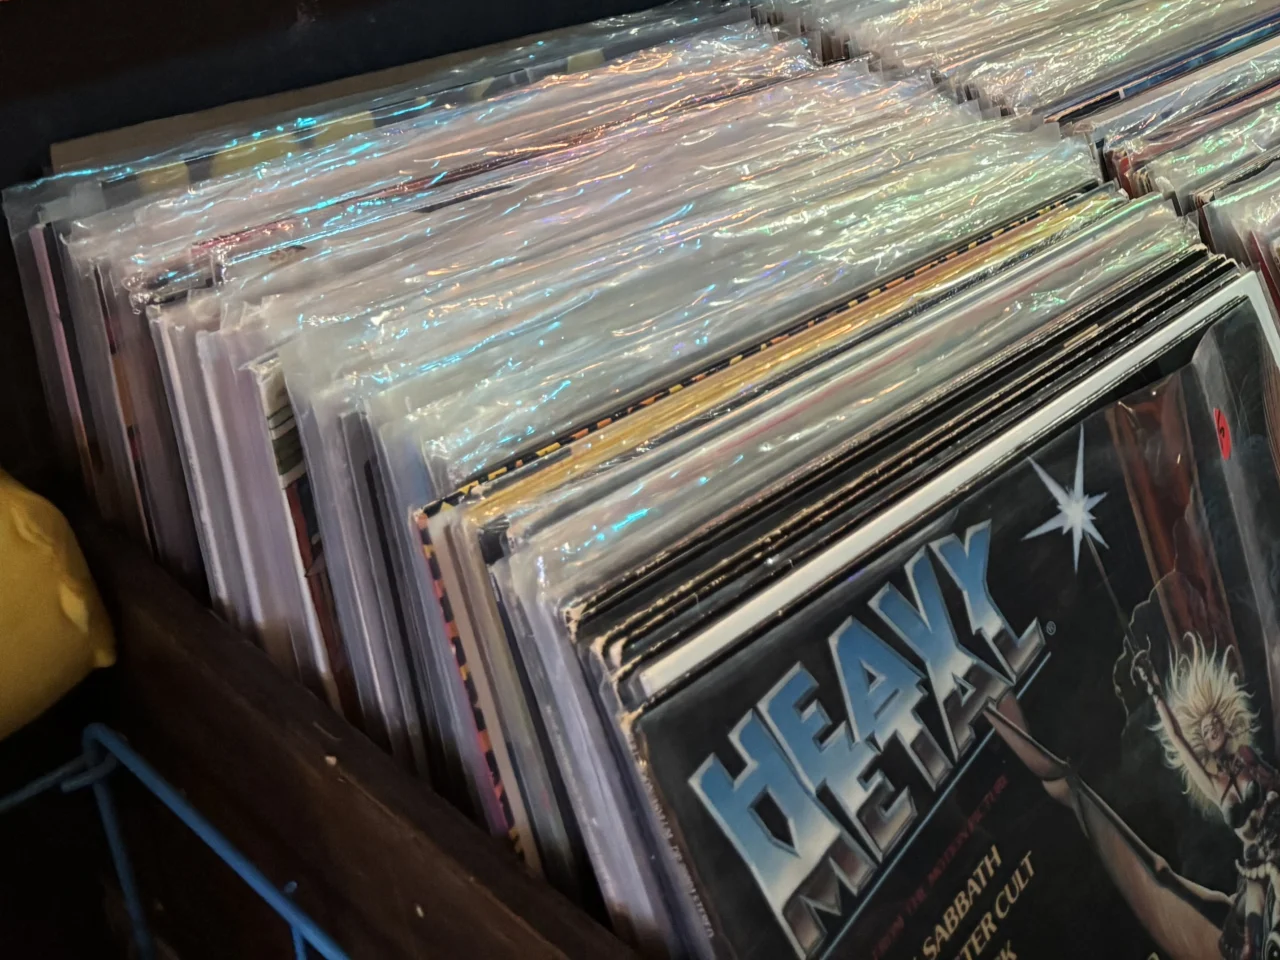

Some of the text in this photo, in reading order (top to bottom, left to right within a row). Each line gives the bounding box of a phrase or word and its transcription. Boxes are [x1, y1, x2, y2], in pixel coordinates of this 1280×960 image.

[688, 518, 1007, 907] HEAVY
[783, 617, 1046, 960] METAL
[922, 844, 1002, 960] SABBATH
[995, 850, 1035, 919] CULT
